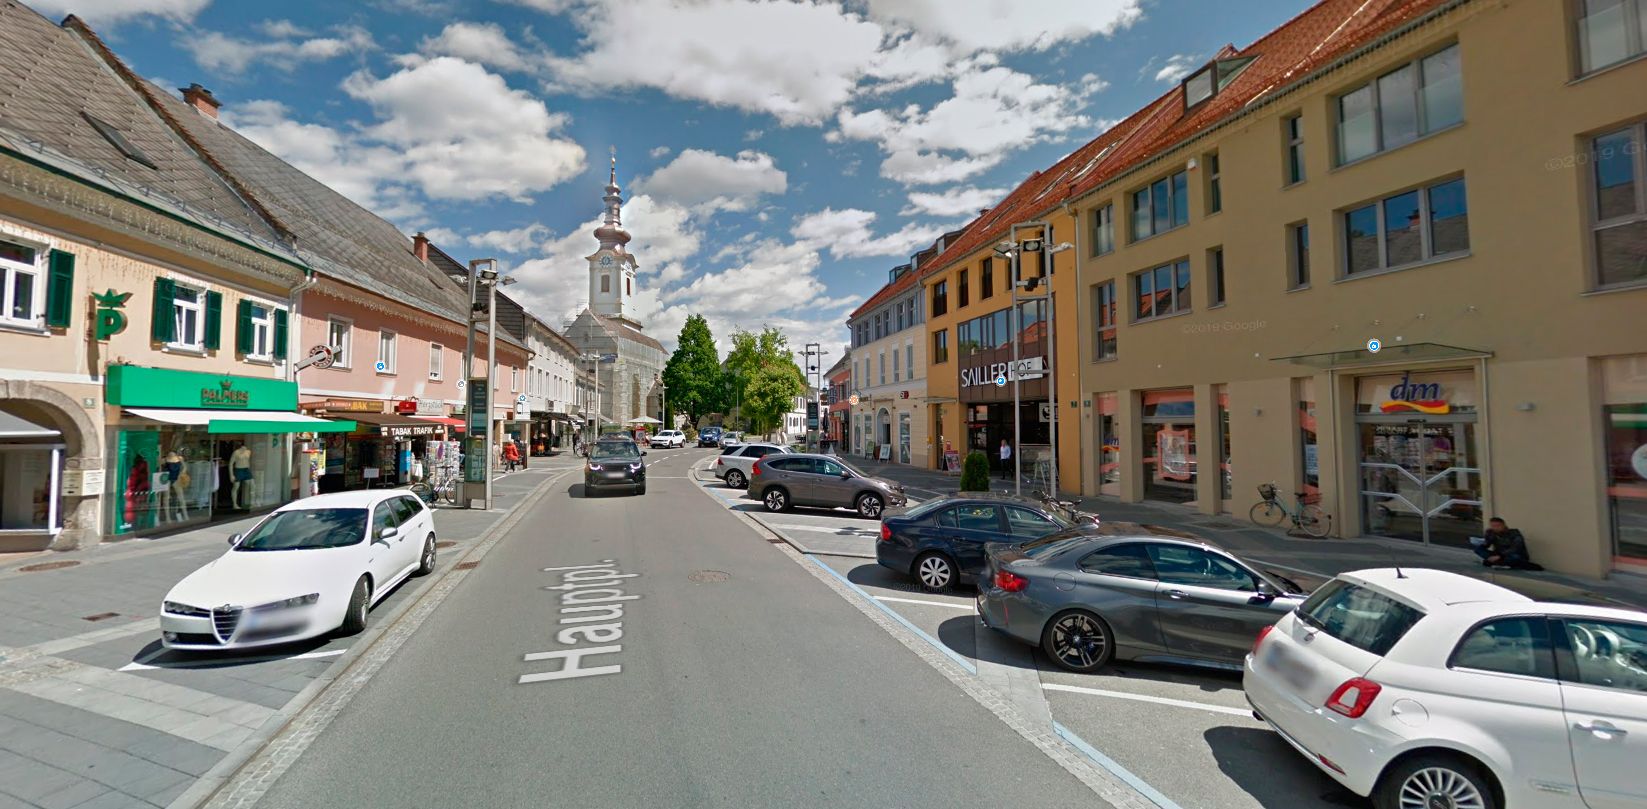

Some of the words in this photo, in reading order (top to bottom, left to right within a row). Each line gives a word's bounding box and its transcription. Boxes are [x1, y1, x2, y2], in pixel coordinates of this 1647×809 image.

[97, 307, 126, 341] P
[961, 362, 1006, 387] SAILLER
[1390, 371, 1440, 402] dm
[391, 427, 412, 436] TABAK
[413, 426, 433, 435] TRAFIK
